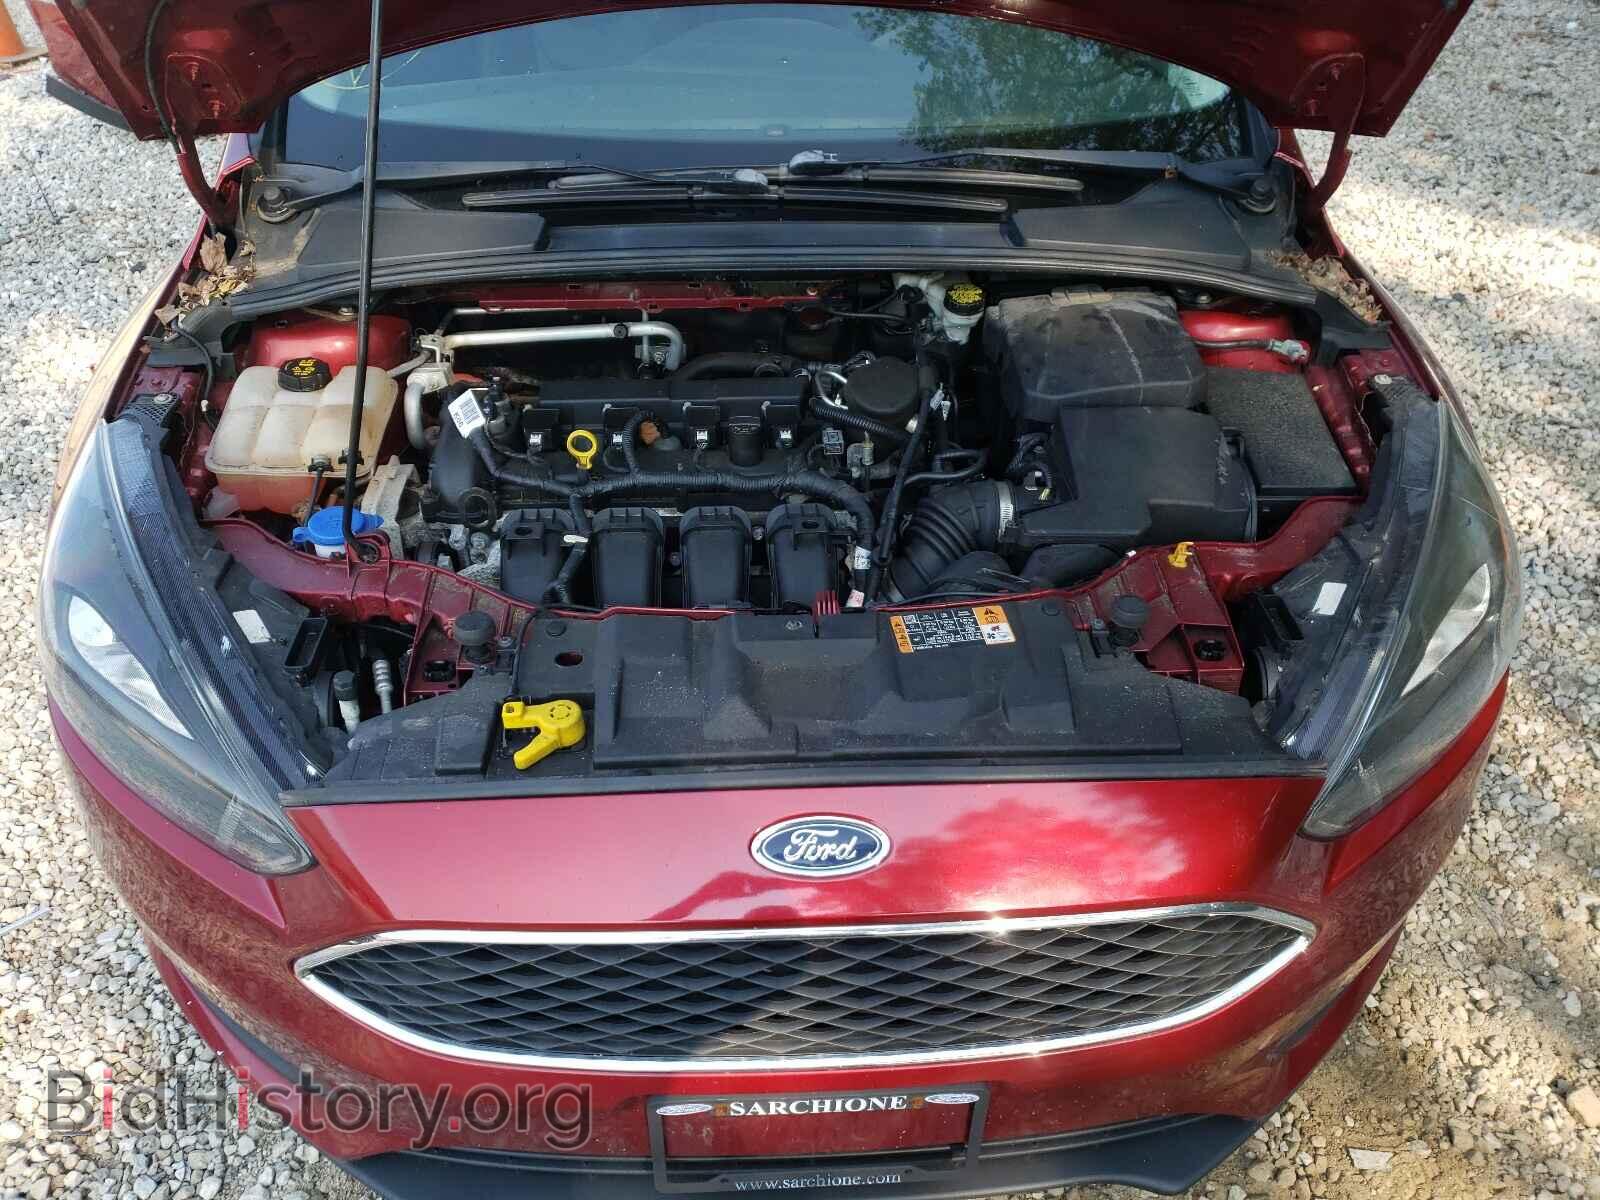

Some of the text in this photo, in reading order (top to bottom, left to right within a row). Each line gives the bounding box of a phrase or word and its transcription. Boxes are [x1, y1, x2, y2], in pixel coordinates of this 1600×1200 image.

[783, 828, 858, 862] Ford
[729, 1095, 908, 1117] SARCHIONE
[735, 1172, 902, 1193] www.sarchione.com
